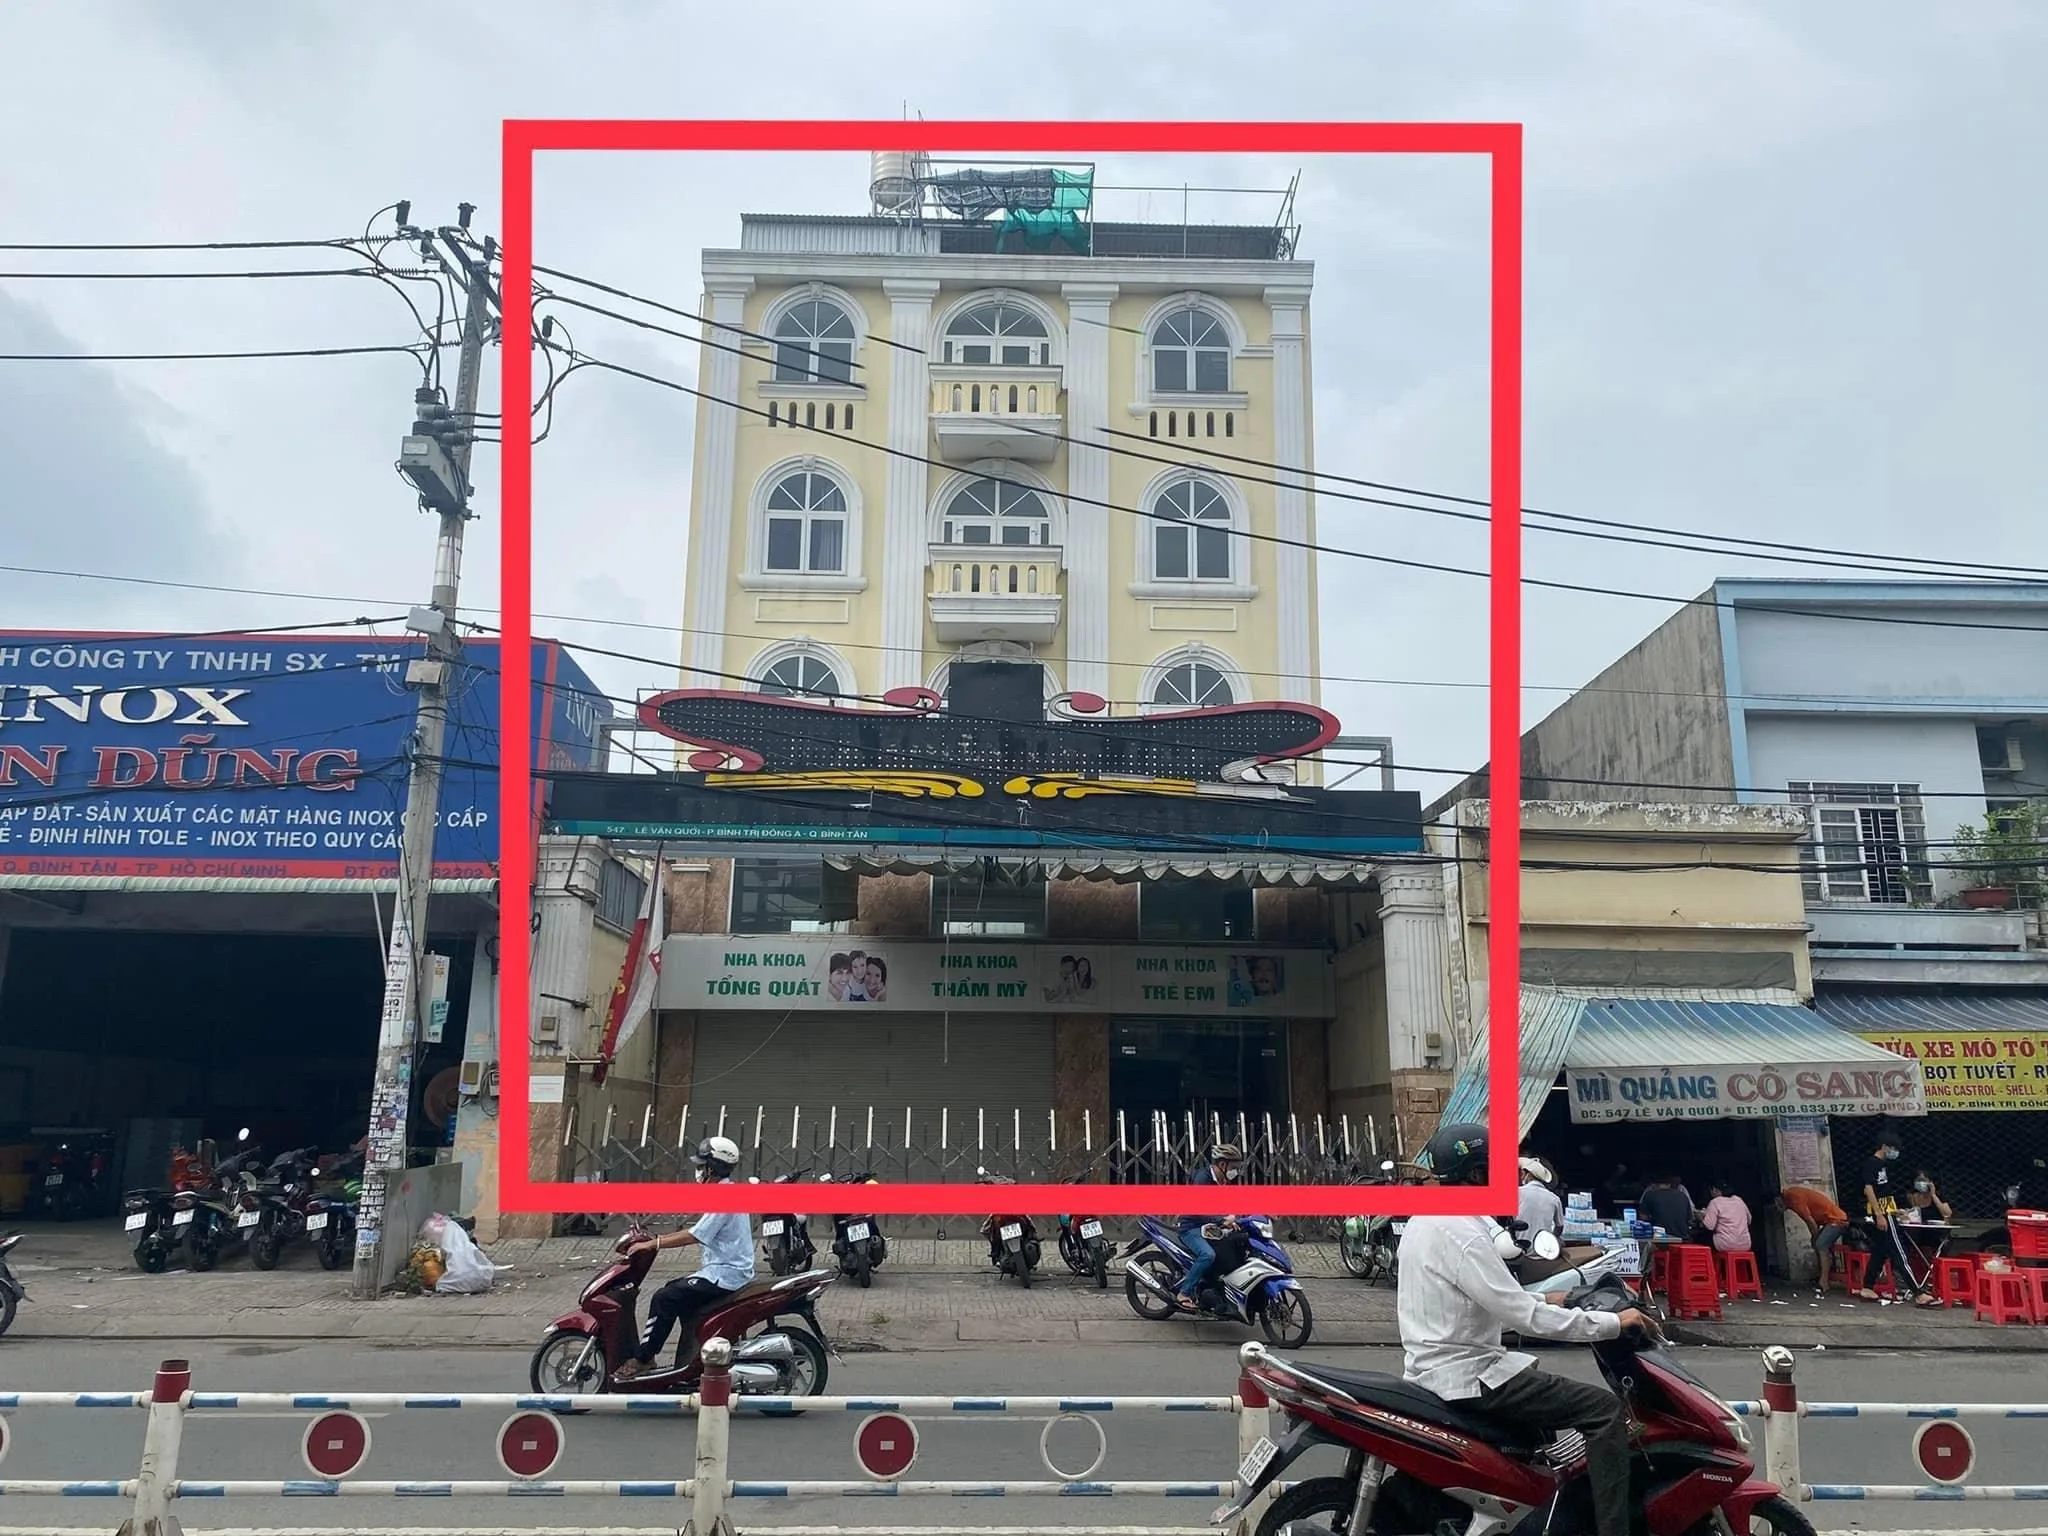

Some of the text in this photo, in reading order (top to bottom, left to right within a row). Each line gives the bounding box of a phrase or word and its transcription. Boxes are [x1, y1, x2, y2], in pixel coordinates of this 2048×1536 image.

[30, 645, 125, 669] CÔNG
[133, 650, 173, 670] TY
[186, 651, 272, 671] TNHH
[285, 653, 327, 672] SX
[356, 654, 400, 673] TM
[88, 733, 363, 792] DŨNG
[132, 801, 186, 823] XUẤT
[192, 804, 234, 824] CÁC
[240, 805, 280, 827] MẶT
[286, 806, 342, 825] HÀNG
[348, 811, 394, 826] INOX
[447, 806, 487, 827] CẤP
[29, 828, 78, 847] ĐỊNH
[83, 826, 130, 845] HÌNH
[137, 829, 189, 846] TOLE
[211, 831, 258, 847] INOX
[264, 831, 316, 848] THEO
[323, 832, 365, 848] QUY
[607, 825, 624, 834] 547
[717, 826, 741, 836] BÌNH
[761, 827, 792, 838] ĐÔNG
[794, 830, 801, 838] A
[821, 829, 845, 838] BÌNH
[847, 829, 868, 839] TÂN
[241, 863, 288, 877] MINH
[724, 953, 807, 967] NHA KHOA
[940, 954, 1018, 969] NHA KHOA
[1136, 958, 1217, 973] NHA KHOA
[706, 974, 821, 997] TỔNG QUÁT
[932, 976, 989, 998] THẨM
[1184, 986, 1215, 1001] EM
[1923, 1041, 1956, 1058] XE
[1961, 1037, 1997, 1058] MÔ
[2003, 1037, 2035, 1058] TÔ
[1924, 1065, 1957, 1082] BỌT
[1963, 1060, 2016, 1080] TUYẾT
[1576, 1064, 1916, 1107] MÌ QUẢNG CÔ SANG
[1953, 1084, 1997, 1097] CASTROL
[2006, 1084, 2037, 1096] SHELL
[1605, 1109, 1632, 1118] 547
[1702, 1472, 1734, 1483] HONDA
